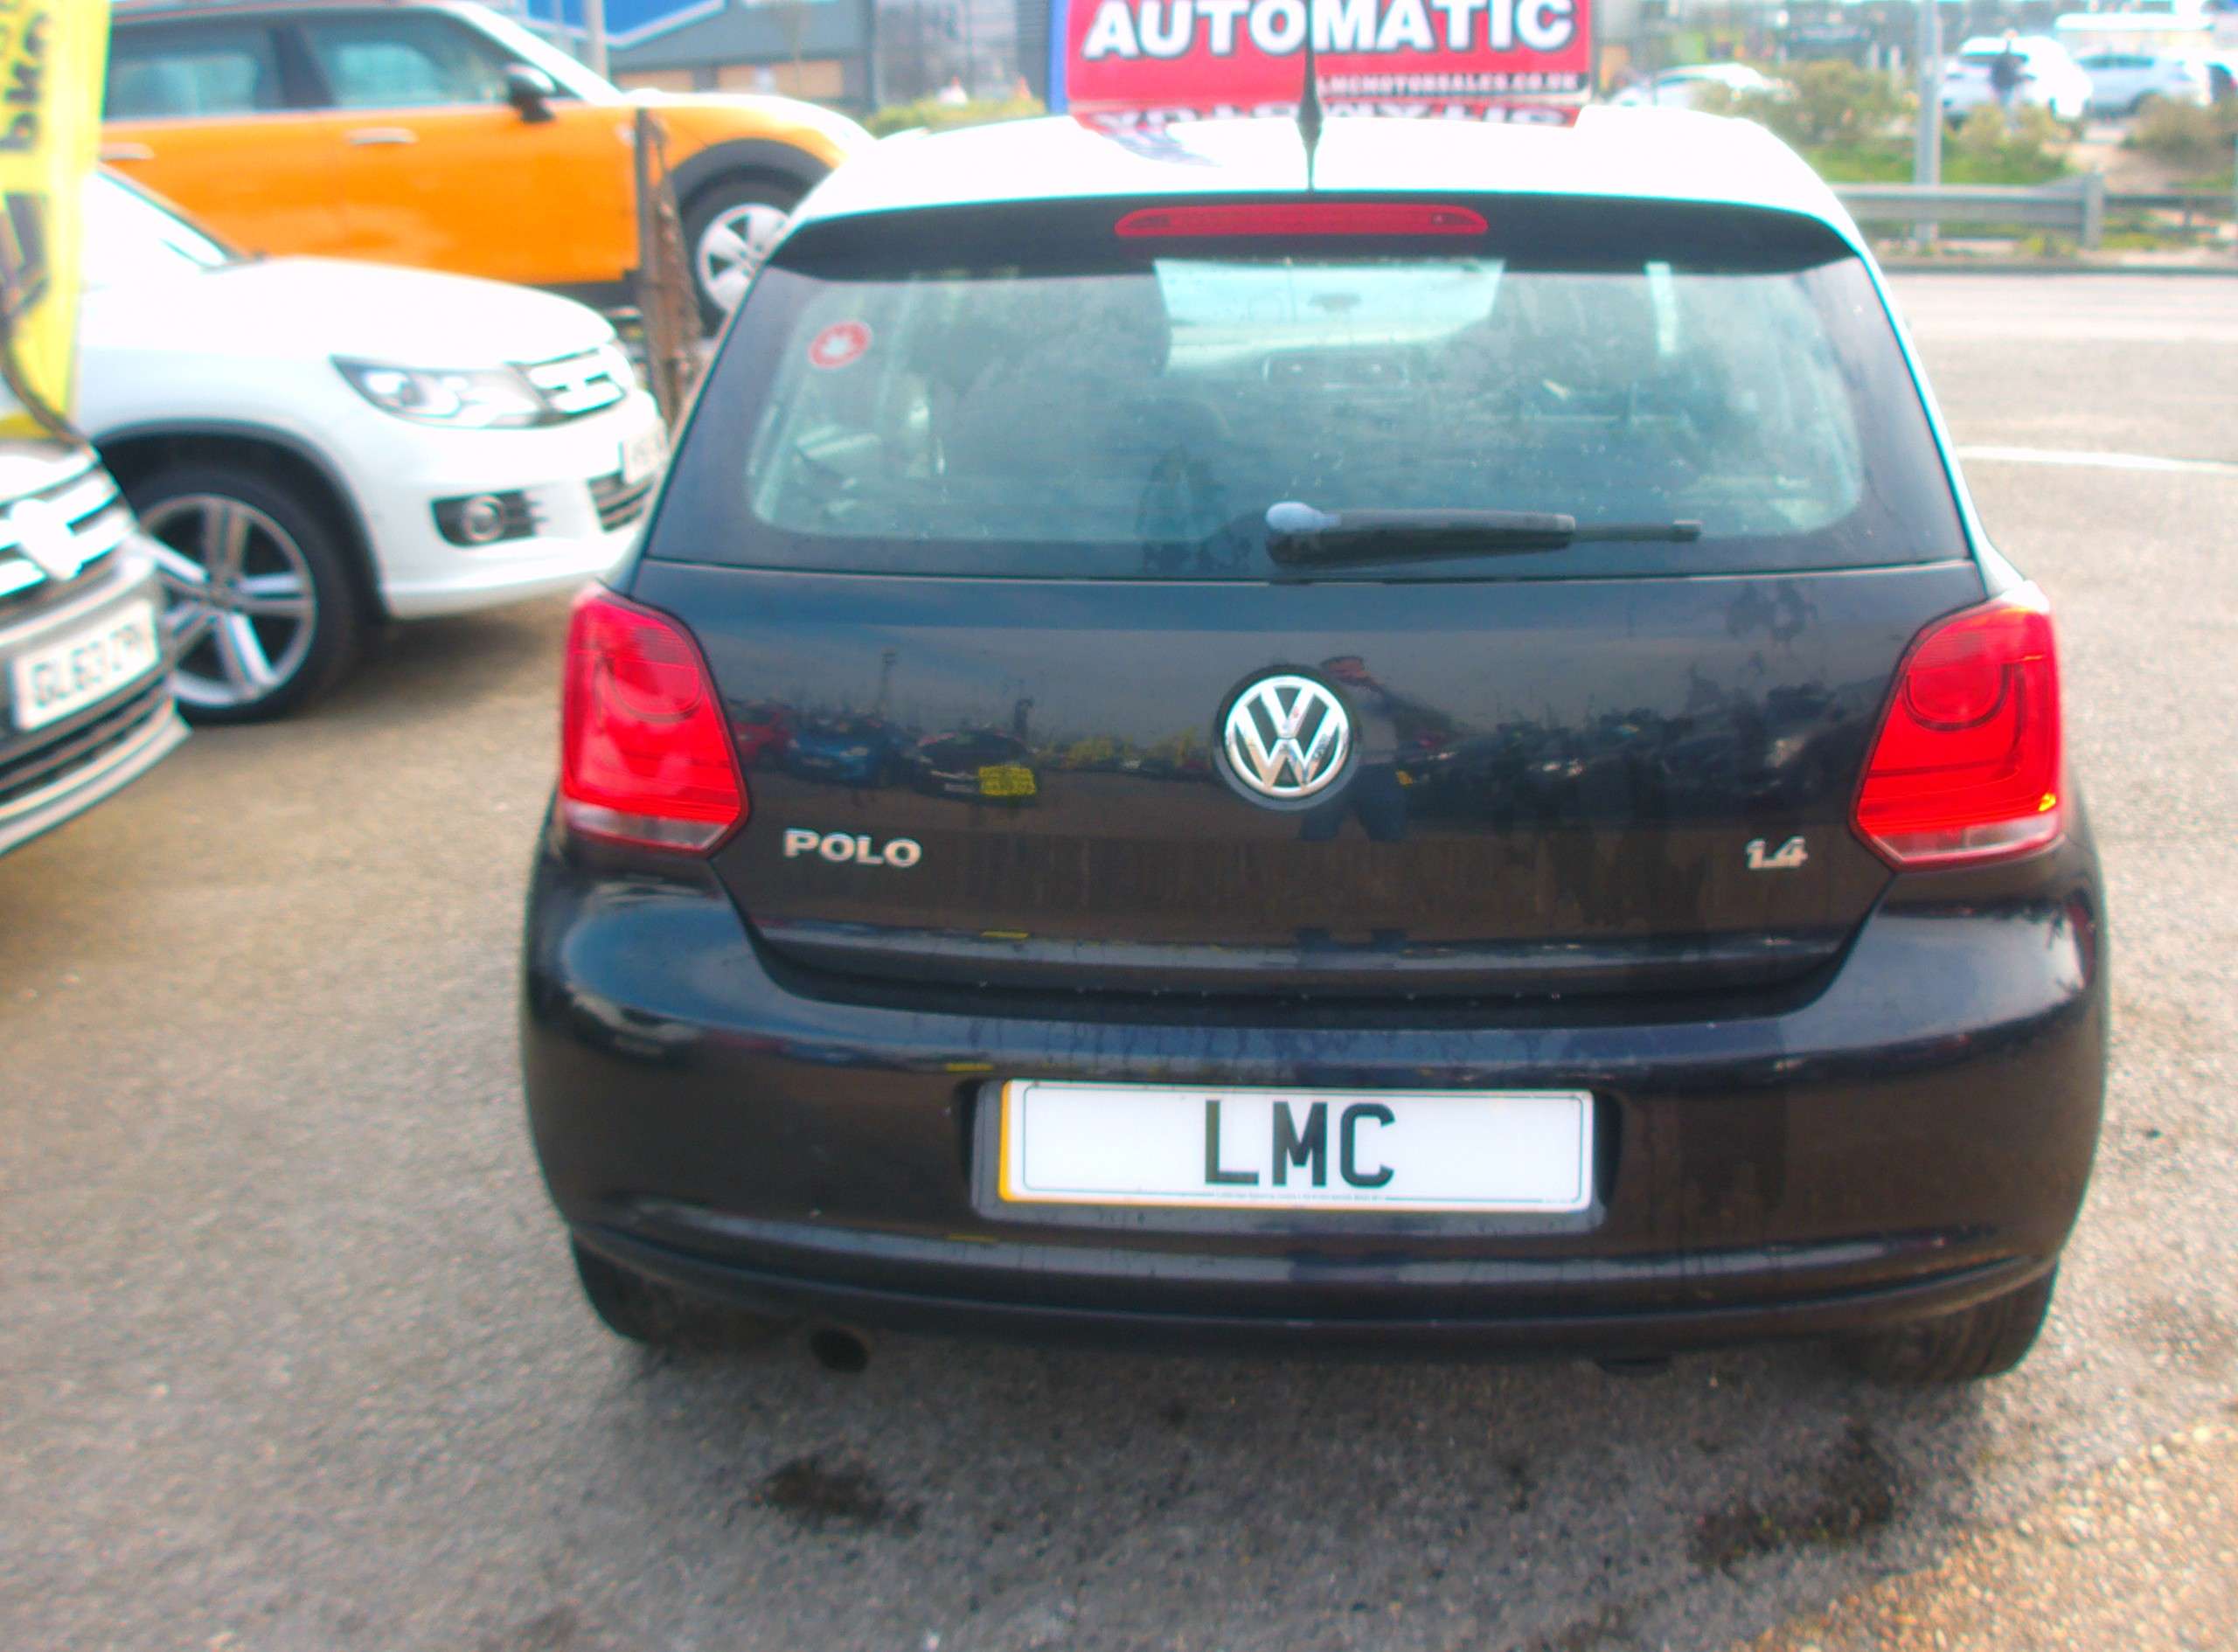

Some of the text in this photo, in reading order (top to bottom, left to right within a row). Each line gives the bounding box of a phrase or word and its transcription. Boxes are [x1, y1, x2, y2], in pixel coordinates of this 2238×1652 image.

[1081, 0, 1573, 58] AUTOMATIC
[783, 828, 921, 867] POLO
[1205, 1099, 1396, 1189] LMC
